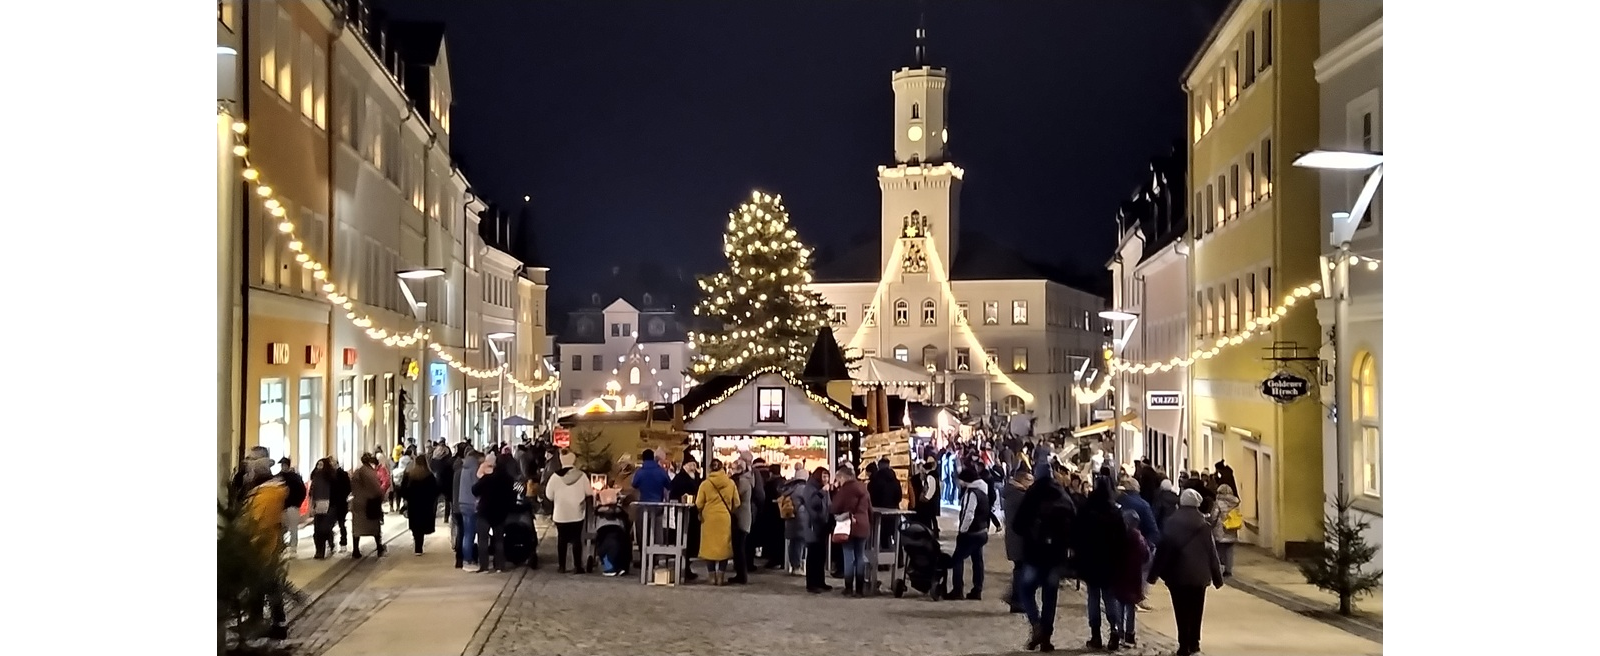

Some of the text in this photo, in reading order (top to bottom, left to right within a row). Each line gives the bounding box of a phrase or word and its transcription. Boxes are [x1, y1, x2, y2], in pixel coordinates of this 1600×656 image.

[273, 342, 290, 364] NKD
[1267, 380, 1303, 388] Goldener
[1151, 396, 1178, 404] POLIZEI
